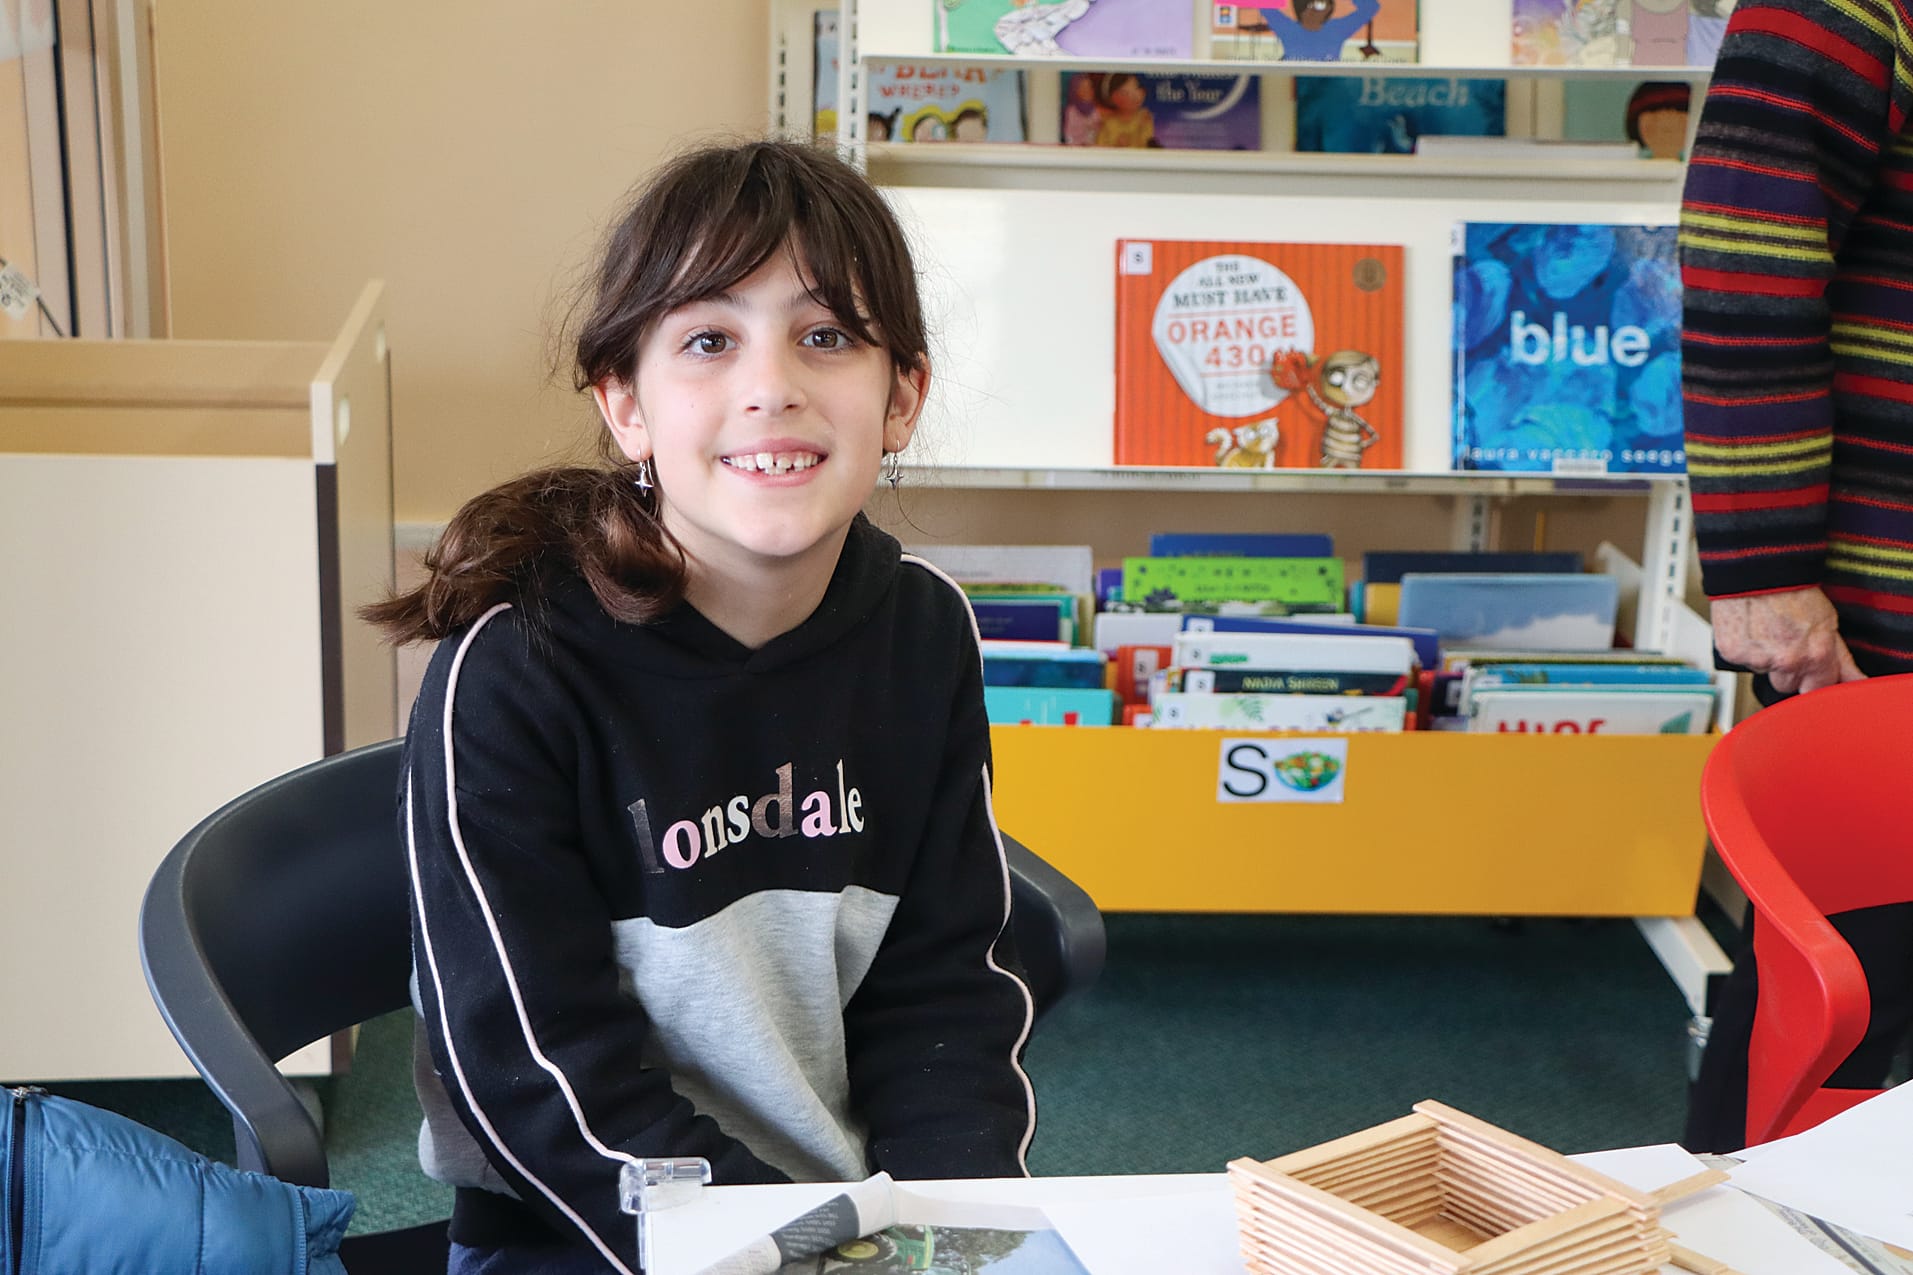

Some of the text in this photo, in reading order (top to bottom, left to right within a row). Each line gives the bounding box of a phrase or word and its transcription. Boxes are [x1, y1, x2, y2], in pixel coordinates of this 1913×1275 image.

[1156, 79, 1223, 101] the Year
[1359, 76, 1469, 107] Beach
[1199, 273, 1261, 287] ALL NEW
[1215, 261, 1240, 272] THE
[1173, 286, 1287, 308] MUST HAVE
[1166, 313, 1297, 345] ORANGE
[1510, 310, 1651, 368] blue
[1205, 344, 1265, 368] 430
[1223, 744, 1268, 797] S
[627, 758, 865, 874] lonsdale
